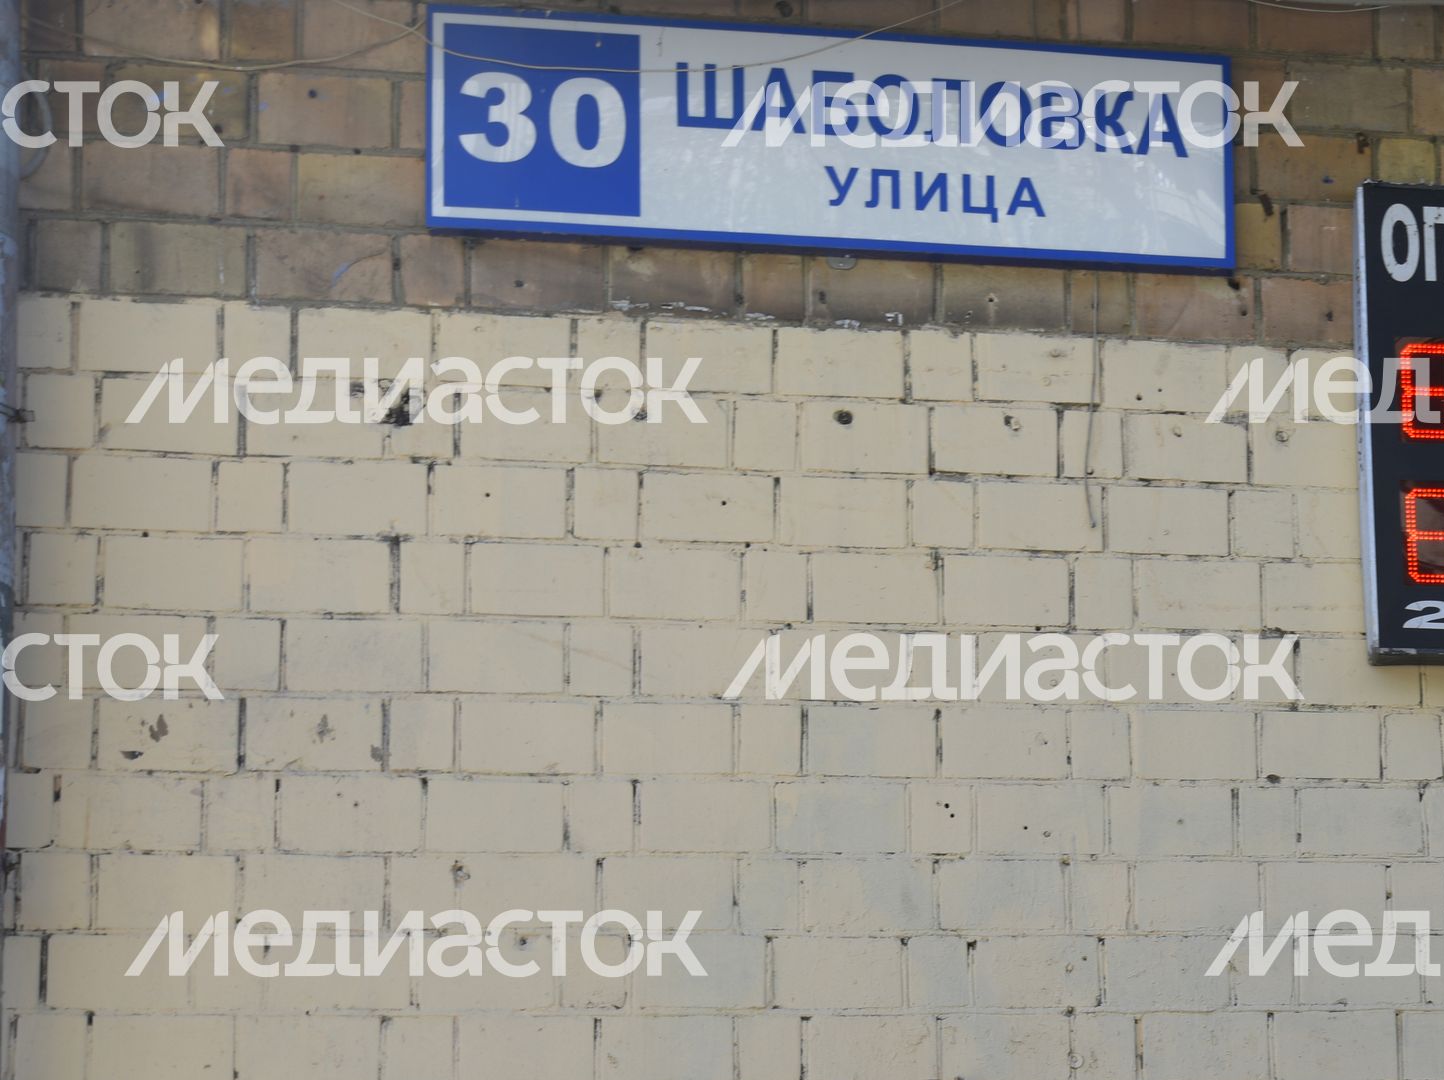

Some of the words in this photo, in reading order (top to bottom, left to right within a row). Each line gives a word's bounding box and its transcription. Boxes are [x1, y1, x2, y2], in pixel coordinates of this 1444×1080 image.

[459, 72, 626, 168] 30
[676, 61, 1189, 158] ШАБОЛОВКА
[825, 164, 1046, 222] УЛИЦА
